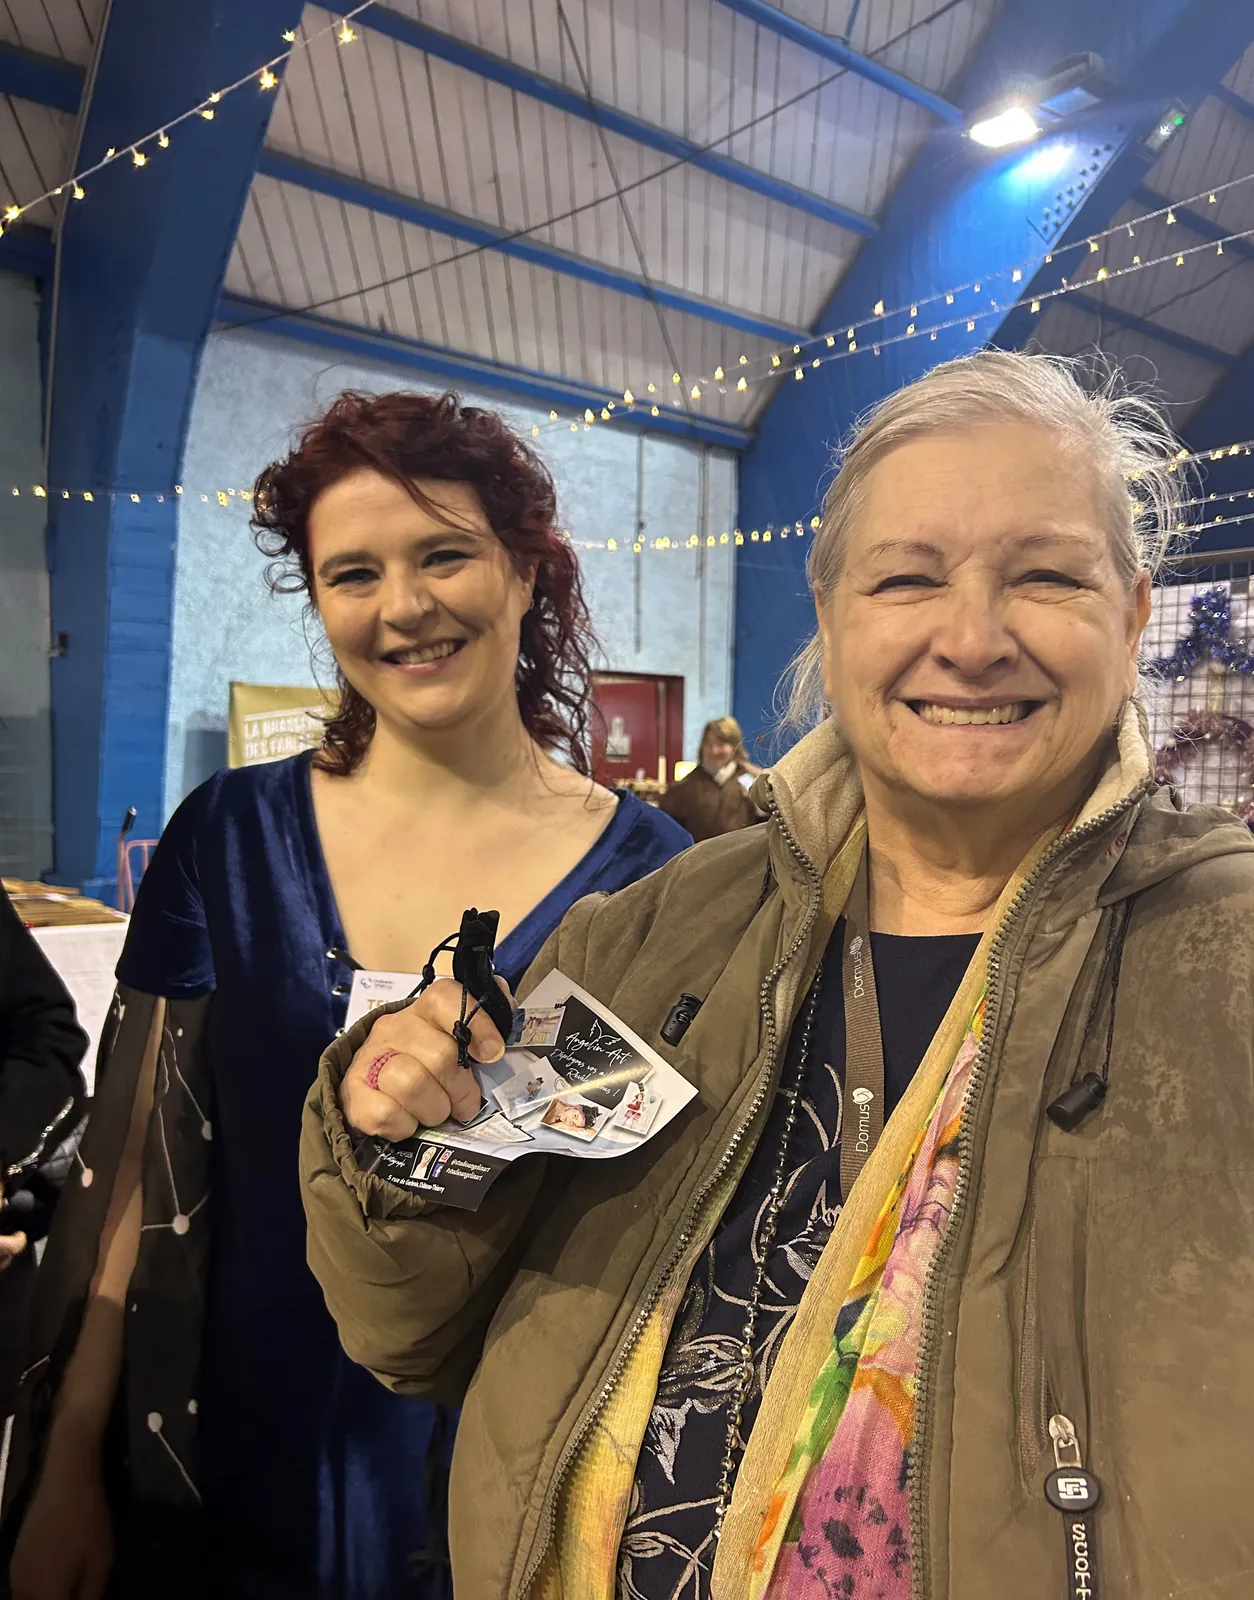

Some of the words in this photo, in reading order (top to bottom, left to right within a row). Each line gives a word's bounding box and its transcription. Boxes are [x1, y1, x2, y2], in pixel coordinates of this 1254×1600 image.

[244, 721, 260, 738] LA
[853, 951, 865, 998] Domus
[565, 1032, 604, 1052] Angelin
[606, 1049, 632, 1067] Art
[855, 1103, 870, 1152] Domus
